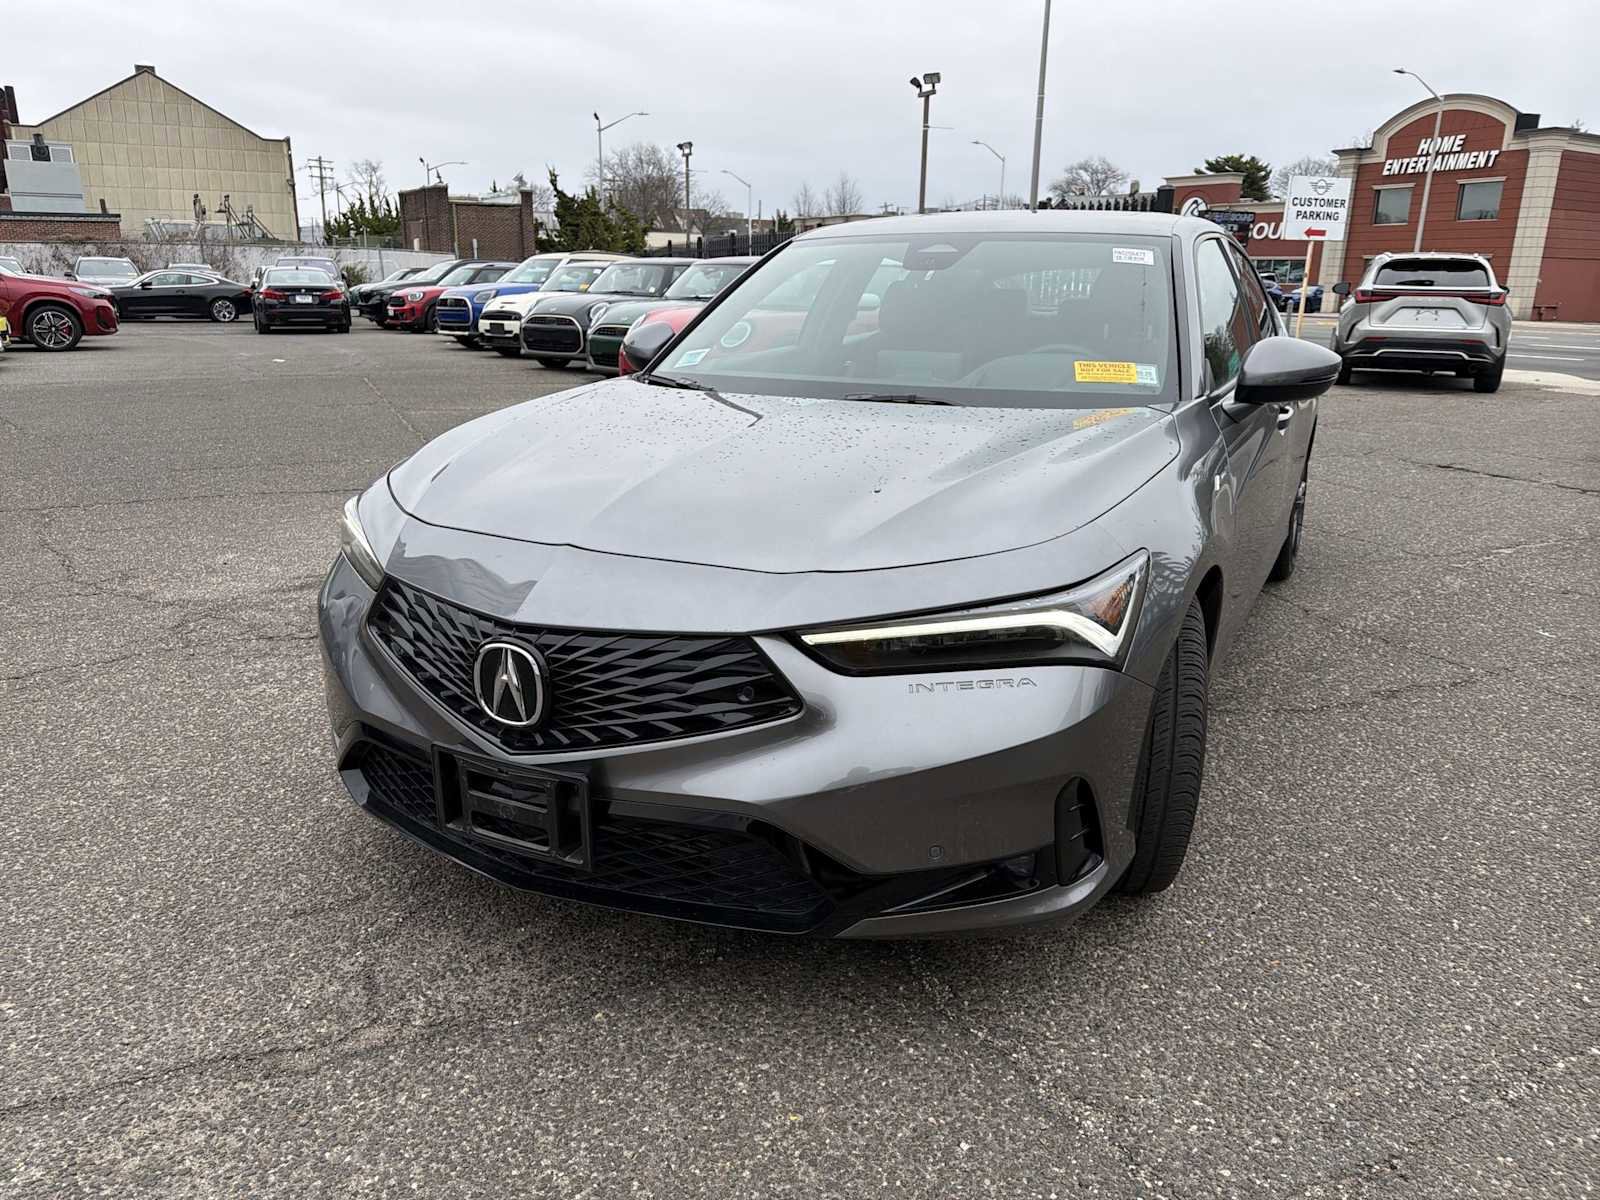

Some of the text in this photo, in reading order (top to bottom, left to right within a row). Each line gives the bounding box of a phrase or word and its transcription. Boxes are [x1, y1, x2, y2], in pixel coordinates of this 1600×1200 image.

[1417, 134, 1467, 156] HOME
[1382, 150, 1500, 176] ENTERTAINMENT
[1291, 197, 1347, 209] CUSTOMER
[1295, 210, 1341, 222] PARKING
[908, 677, 1038, 694] INTEGRA
